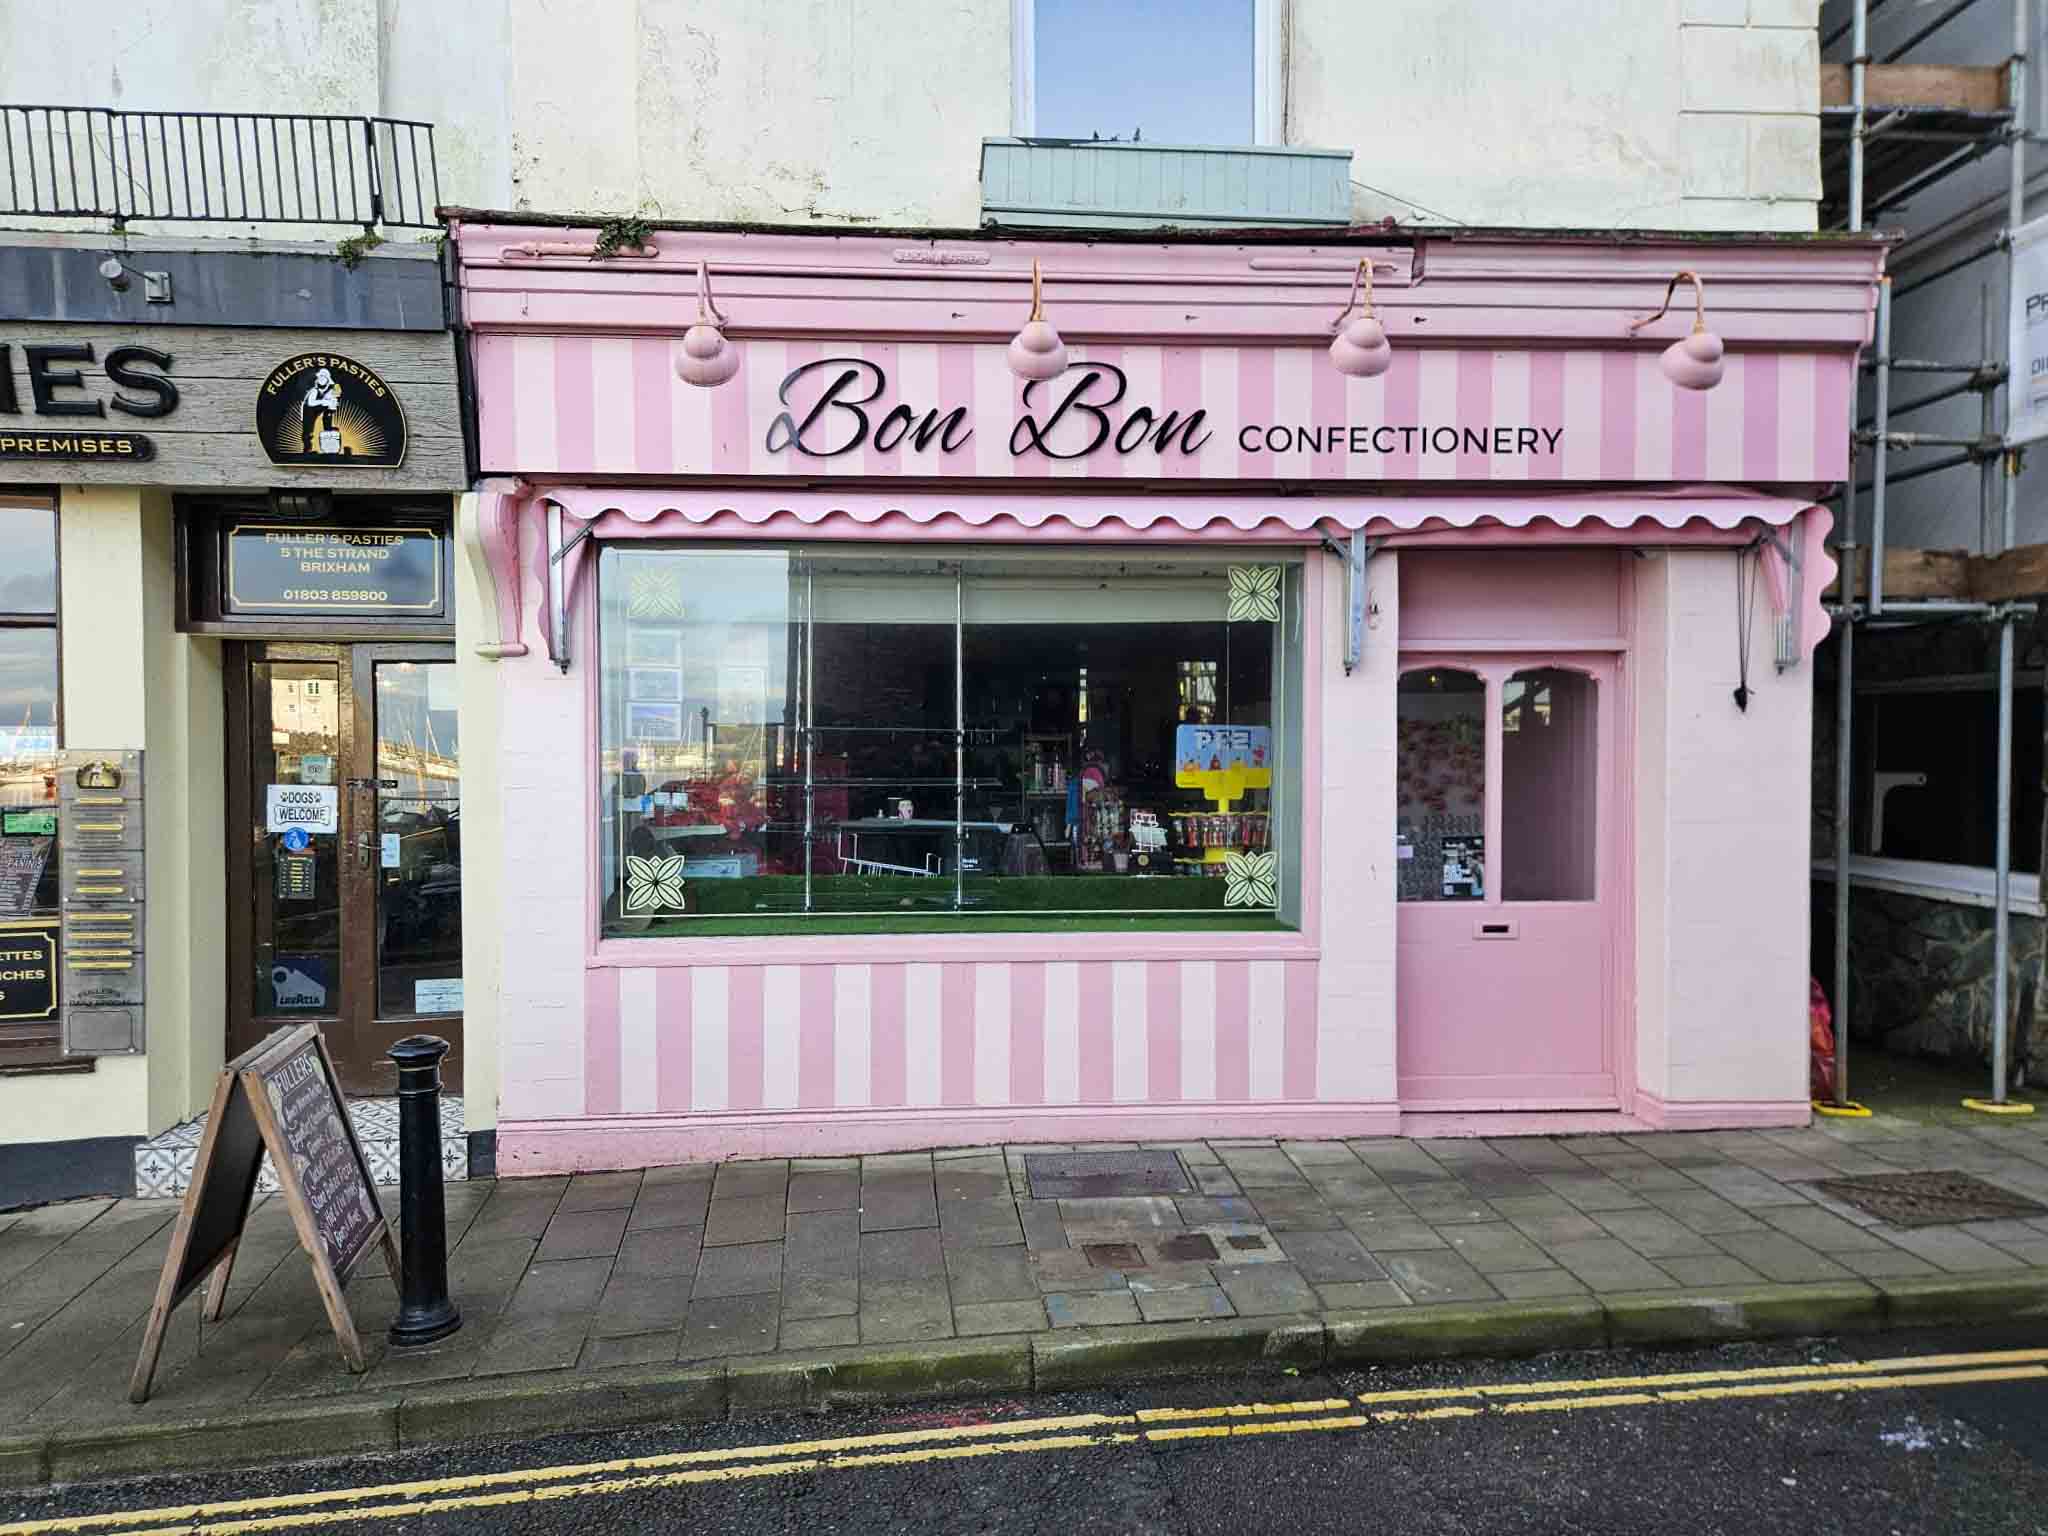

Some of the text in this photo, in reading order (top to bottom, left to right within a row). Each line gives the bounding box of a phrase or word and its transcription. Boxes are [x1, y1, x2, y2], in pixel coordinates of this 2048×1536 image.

[266, 356, 386, 398] FULLER'S PASTIES
[766, 357, 1564, 459] Bon Bon CONFECTIONERY
[0, 438, 133, 454] PREMISES
[265, 532, 404, 546] FULLER'S PASTIES
[293, 547, 324, 560] THE
[327, 547, 390, 560] STRAND
[300, 561, 371, 574] BRIXHAM
[283, 589, 329, 601] 01803
[288, 791, 314, 804] DOGS
[280, 808, 327, 821] WELCOME
[0, 969, 46, 982] CHES
[274, 1053, 313, 1097] FULLERS
